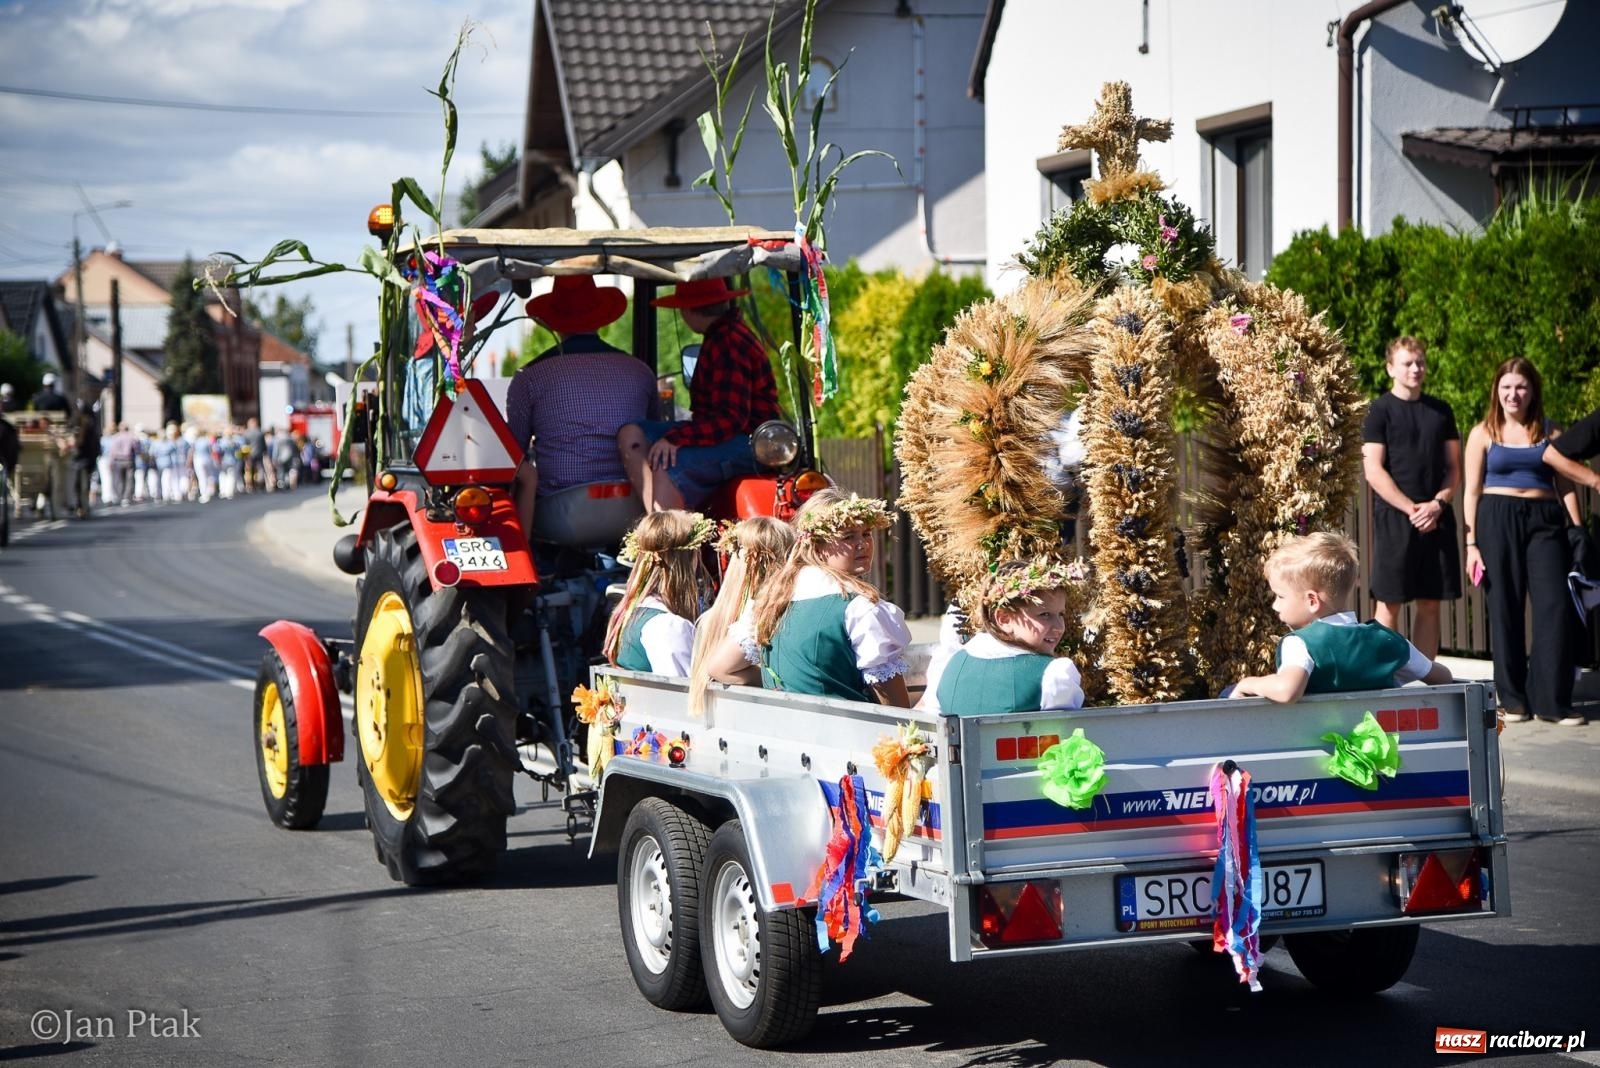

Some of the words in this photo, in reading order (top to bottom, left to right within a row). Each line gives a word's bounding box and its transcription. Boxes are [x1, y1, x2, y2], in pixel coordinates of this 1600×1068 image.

[459, 540, 493, 553] SRC
[454, 555, 502, 567] 34X6
[1144, 876, 1212, 917] SRC
[1122, 906, 1135, 916] PL
